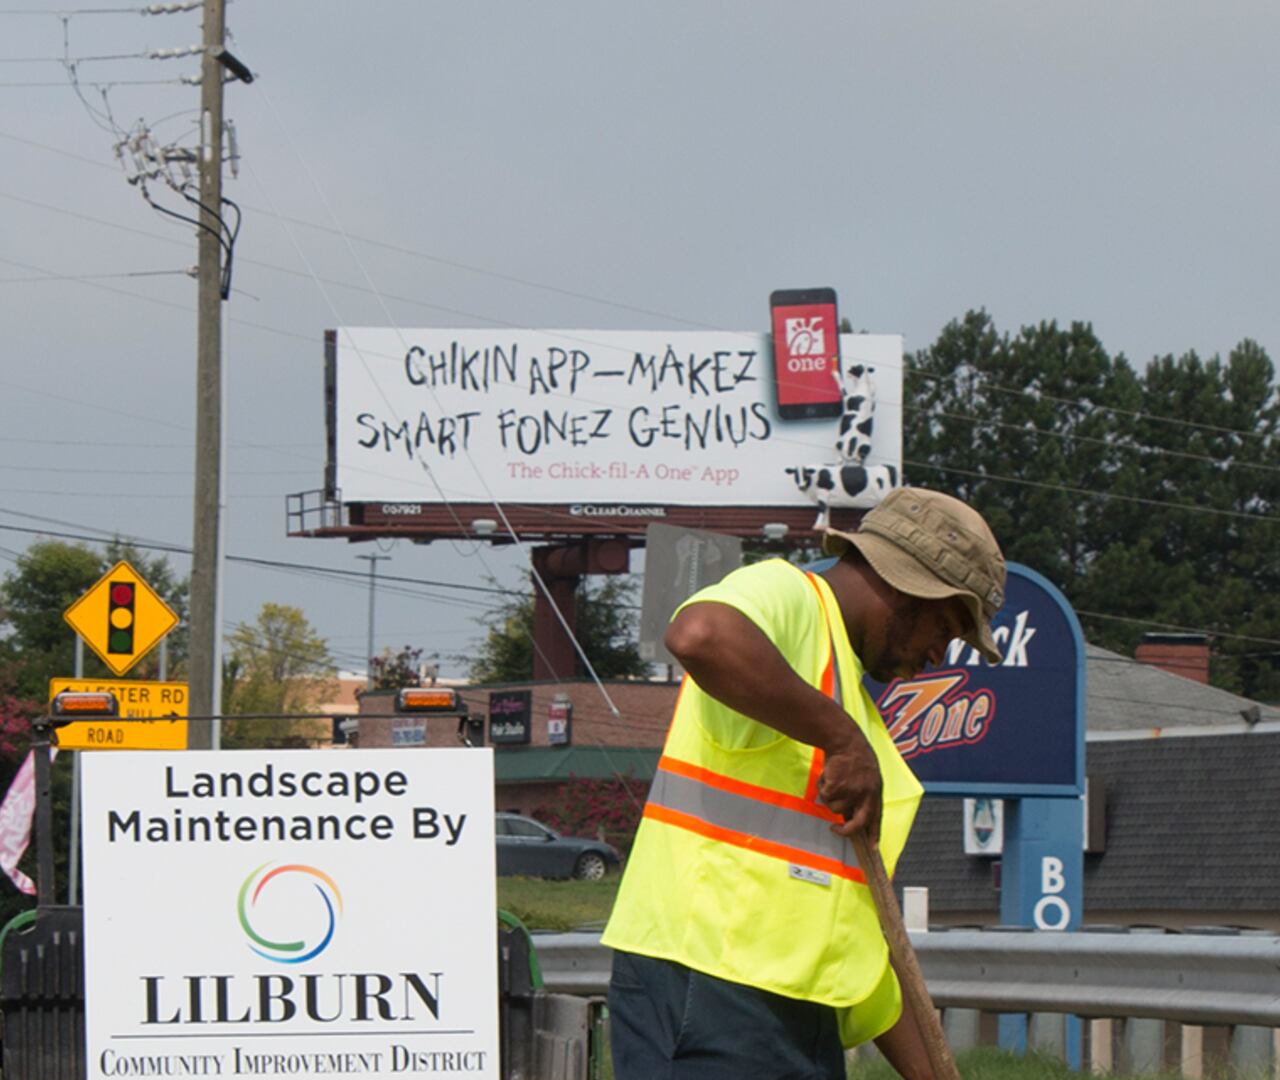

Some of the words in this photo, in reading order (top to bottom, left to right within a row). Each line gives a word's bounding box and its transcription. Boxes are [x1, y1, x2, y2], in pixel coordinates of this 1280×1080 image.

[405, 341, 518, 393] CHIKIN
[787, 357, 826, 372] one
[356, 410, 481, 460] SMART
[498, 408, 613, 455] FONEZ
[628, 402, 771, 451] GENIUS
[507, 462, 543, 479] The
[548, 462, 650, 480] Chick-fil-A
[701, 466, 740, 486] App
[85, 686, 151, 703] TER
[161, 689, 185, 704] RD
[878, 671, 993, 757] Zone
[87, 728, 124, 744] ROAD
[166, 764, 408, 803] Landscape
[107, 809, 394, 842] Maintenance
[412, 807, 467, 846] By
[139, 972, 444, 1024] LILBURN
[100, 1048, 225, 1077] COMMUNITY
[233, 1046, 383, 1075] IMPROVEMENT
[390, 1044, 488, 1073] DISTRICT
